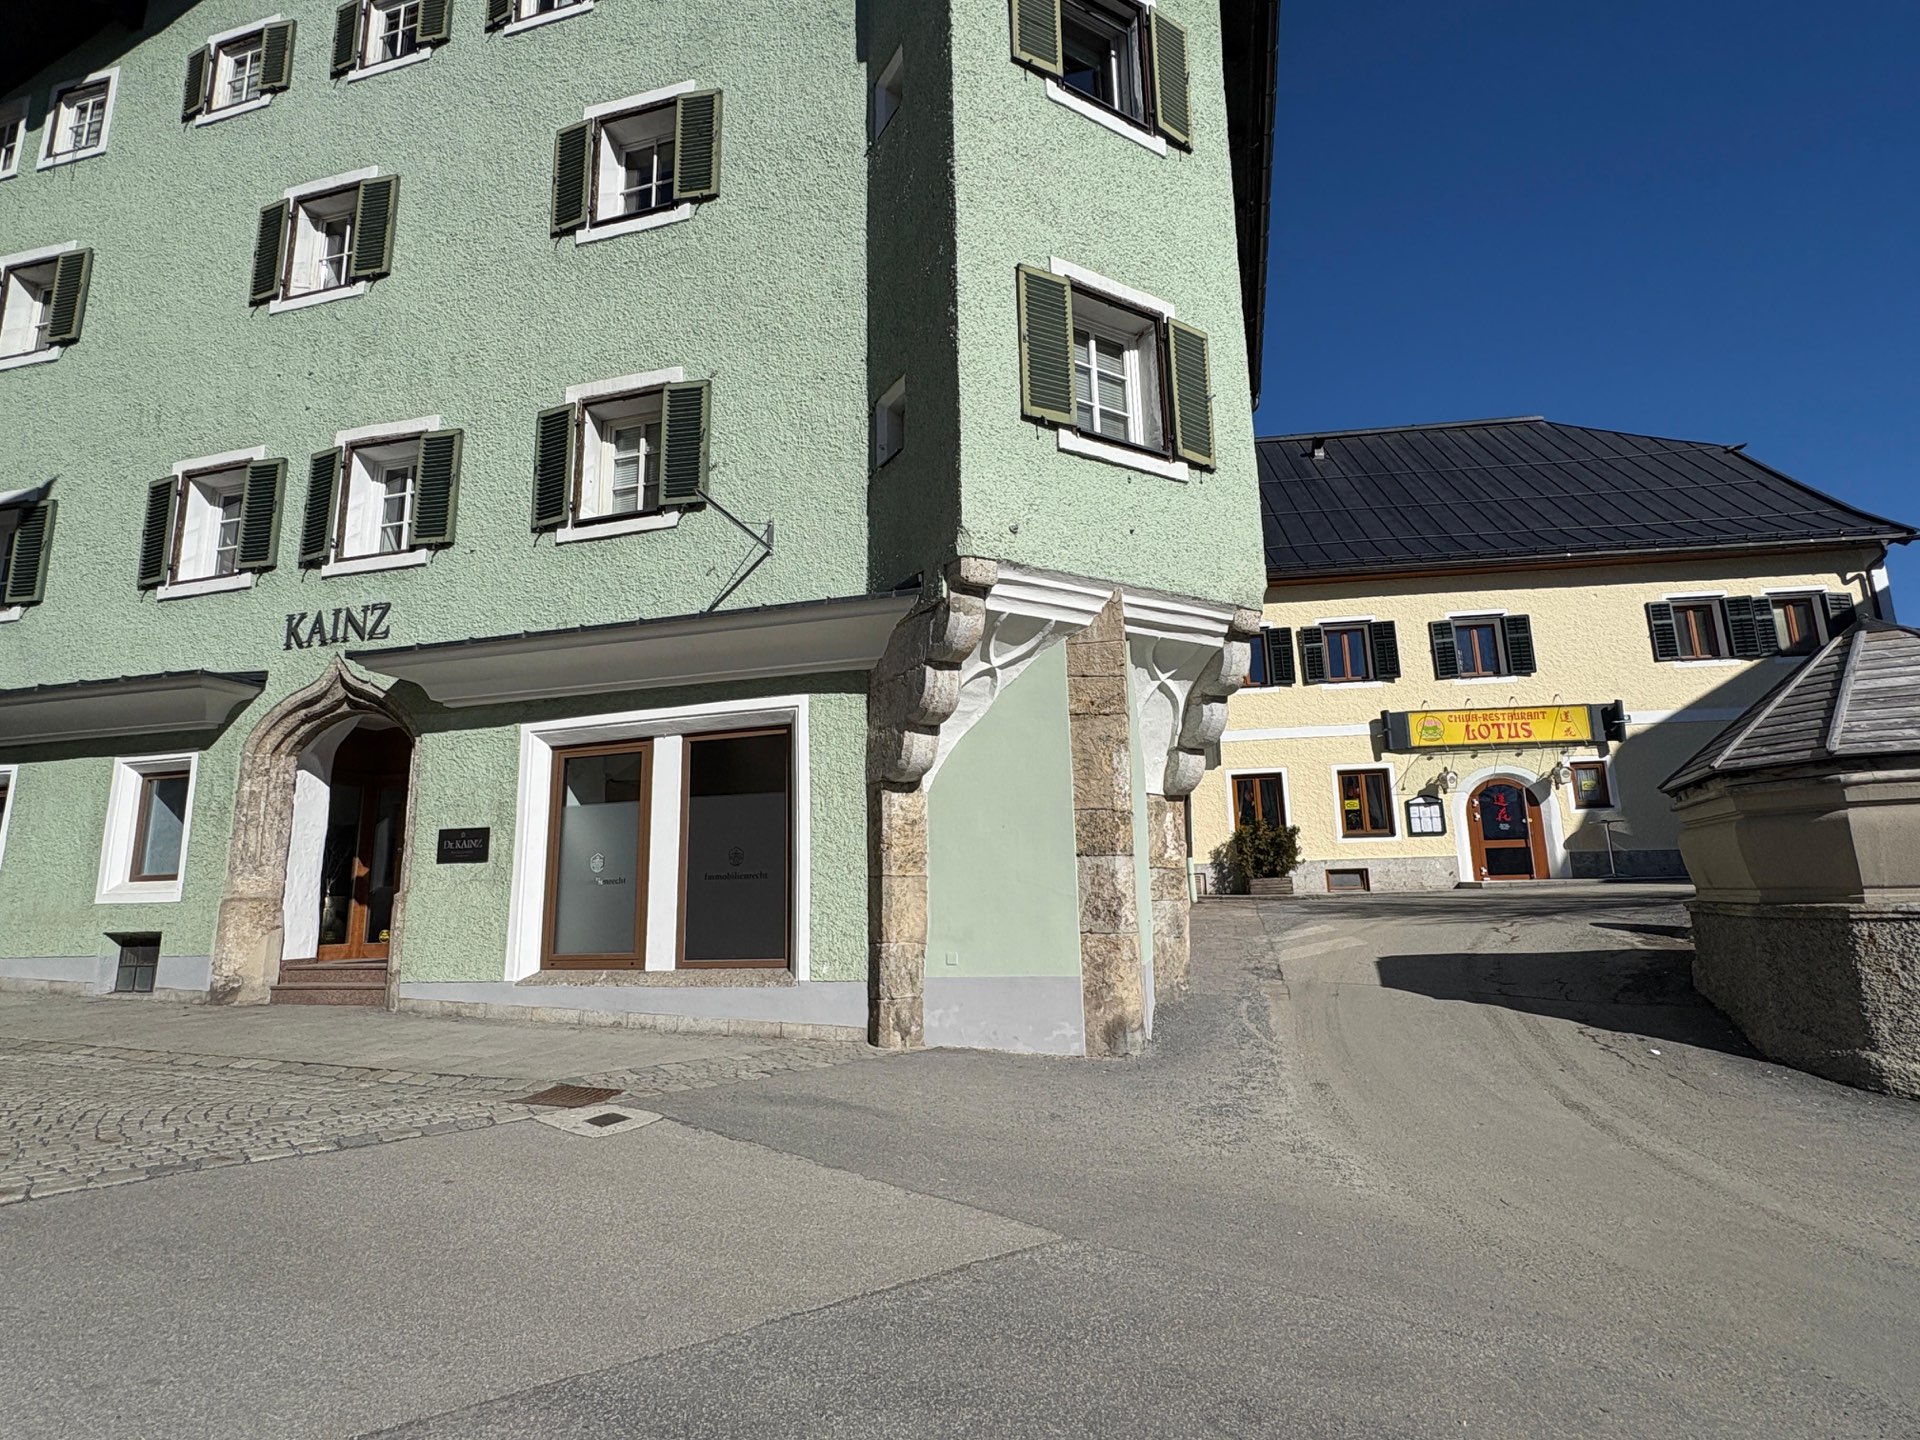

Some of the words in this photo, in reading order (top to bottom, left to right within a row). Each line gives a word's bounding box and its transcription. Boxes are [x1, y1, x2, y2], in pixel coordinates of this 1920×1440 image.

[283, 602, 392, 651] KAINZ
[1447, 710, 1547, 723] CHINA-RESTAURANT
[1465, 722, 1533, 741] LOTUS
[704, 870, 769, 881] Immobilienrecht
